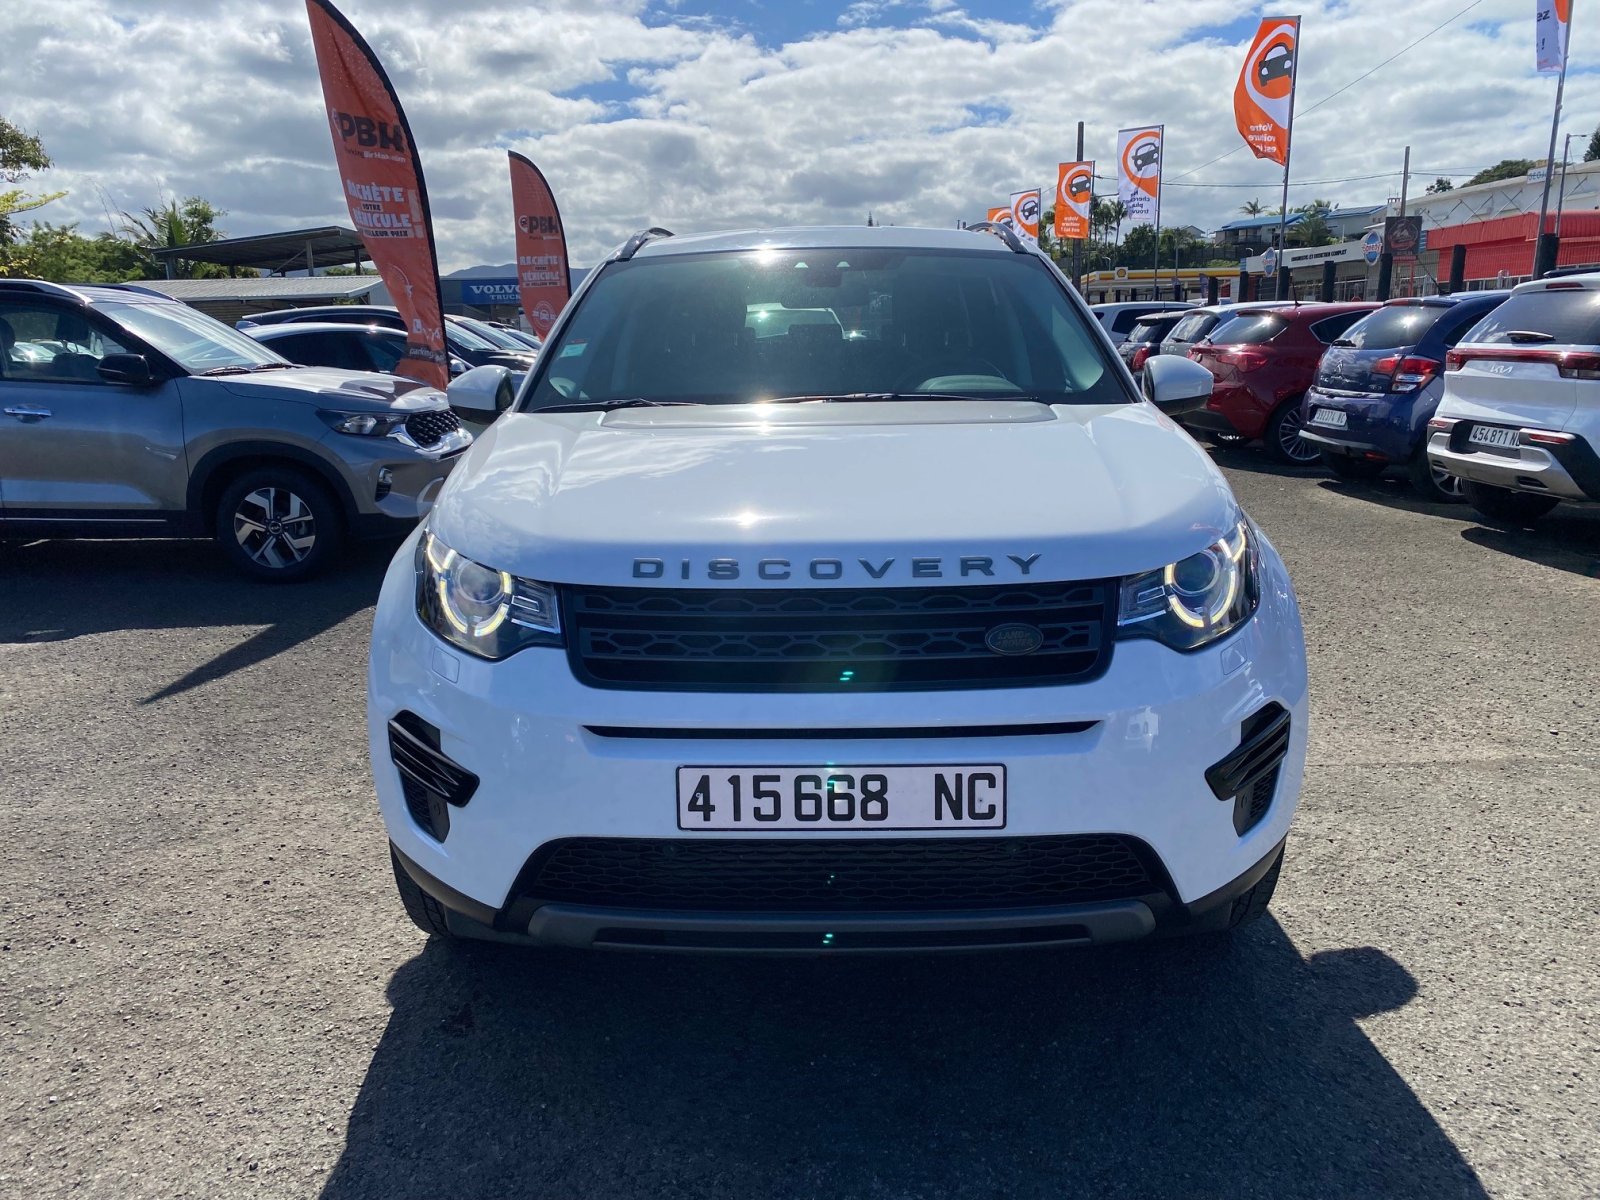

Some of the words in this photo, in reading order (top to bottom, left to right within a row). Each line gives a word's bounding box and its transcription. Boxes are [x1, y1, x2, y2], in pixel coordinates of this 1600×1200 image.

[337, 112, 404, 152] PBH
[529, 216, 559, 233] PBH
[1473, 427, 1509, 445] 454871
[632, 553, 1041, 580] DISCOVERY
[687, 774, 888, 822] 415668
[934, 773, 996, 821] NC
